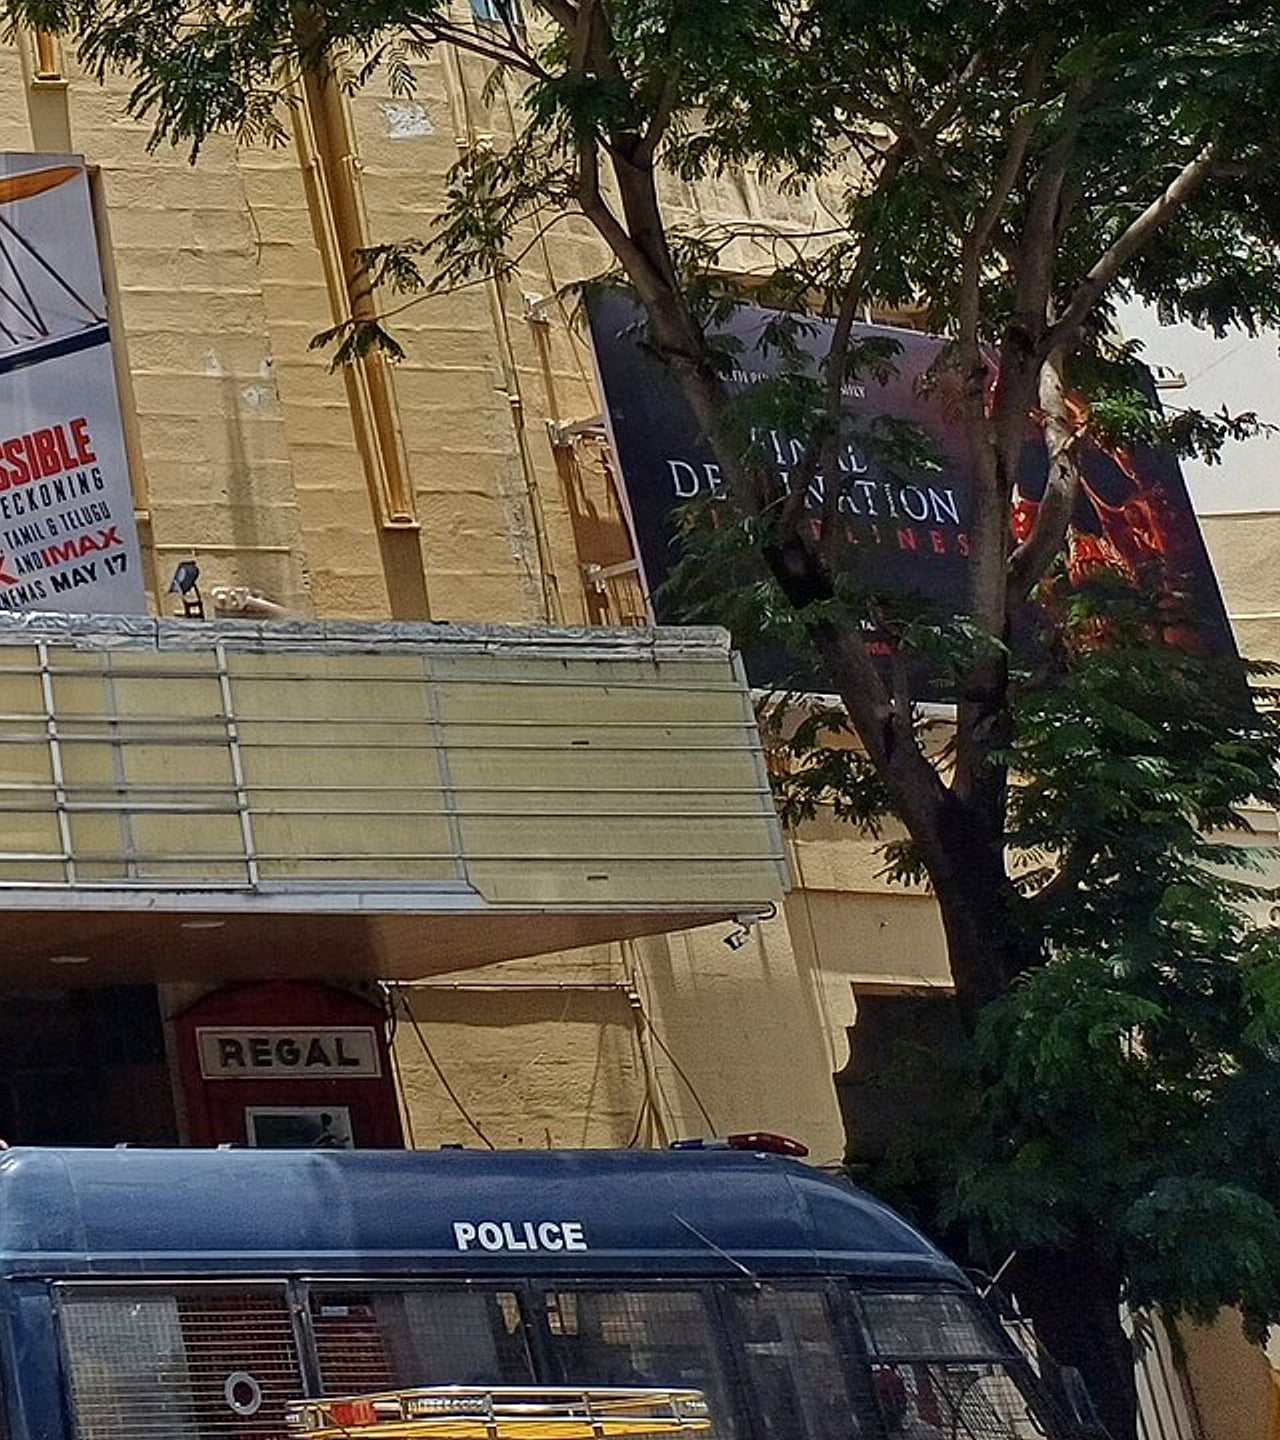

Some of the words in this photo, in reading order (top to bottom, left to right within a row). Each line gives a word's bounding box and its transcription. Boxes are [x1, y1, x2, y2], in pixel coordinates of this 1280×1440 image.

[4, 526, 46, 550] TAMIL
[48, 518, 59, 535] &
[60, 500, 111, 532] TELUGU
[16, 553, 44, 575] AND
[42, 526, 124, 569] IMAX
[50, 561, 97, 594] MAY
[103, 552, 128, 576] 17
[218, 1037, 360, 1068] REGAL
[452, 1221, 588, 1250] POLICE
